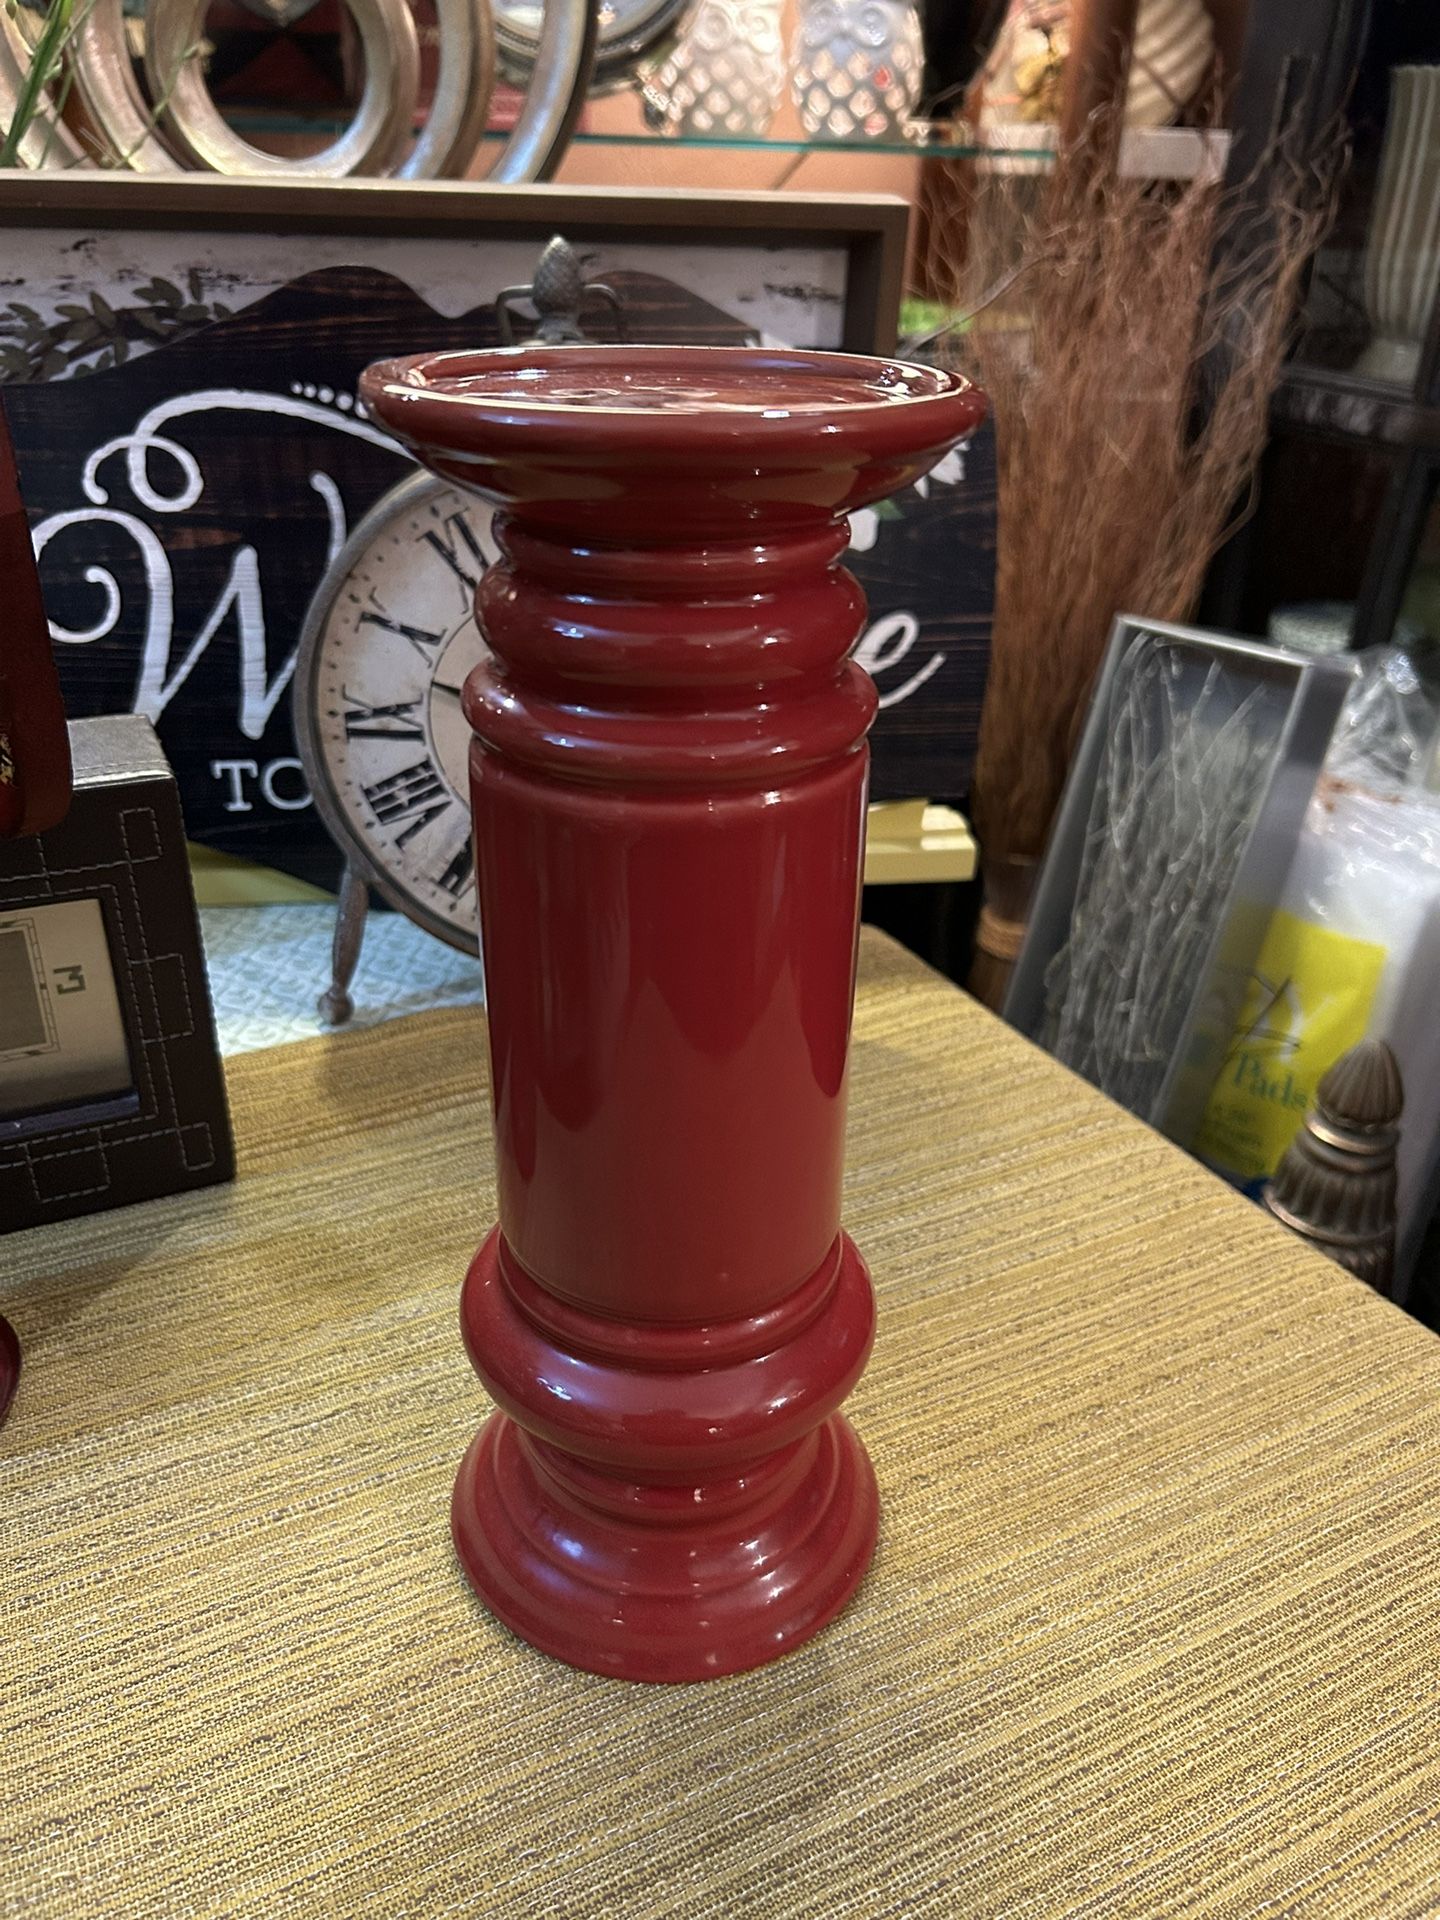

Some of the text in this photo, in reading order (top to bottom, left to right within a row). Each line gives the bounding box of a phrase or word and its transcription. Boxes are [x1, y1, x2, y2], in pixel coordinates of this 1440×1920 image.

[354, 588, 447, 667] X
[342, 685, 426, 746] IX
[360, 759, 453, 852] VIII
[53, 965, 86, 995] 3
